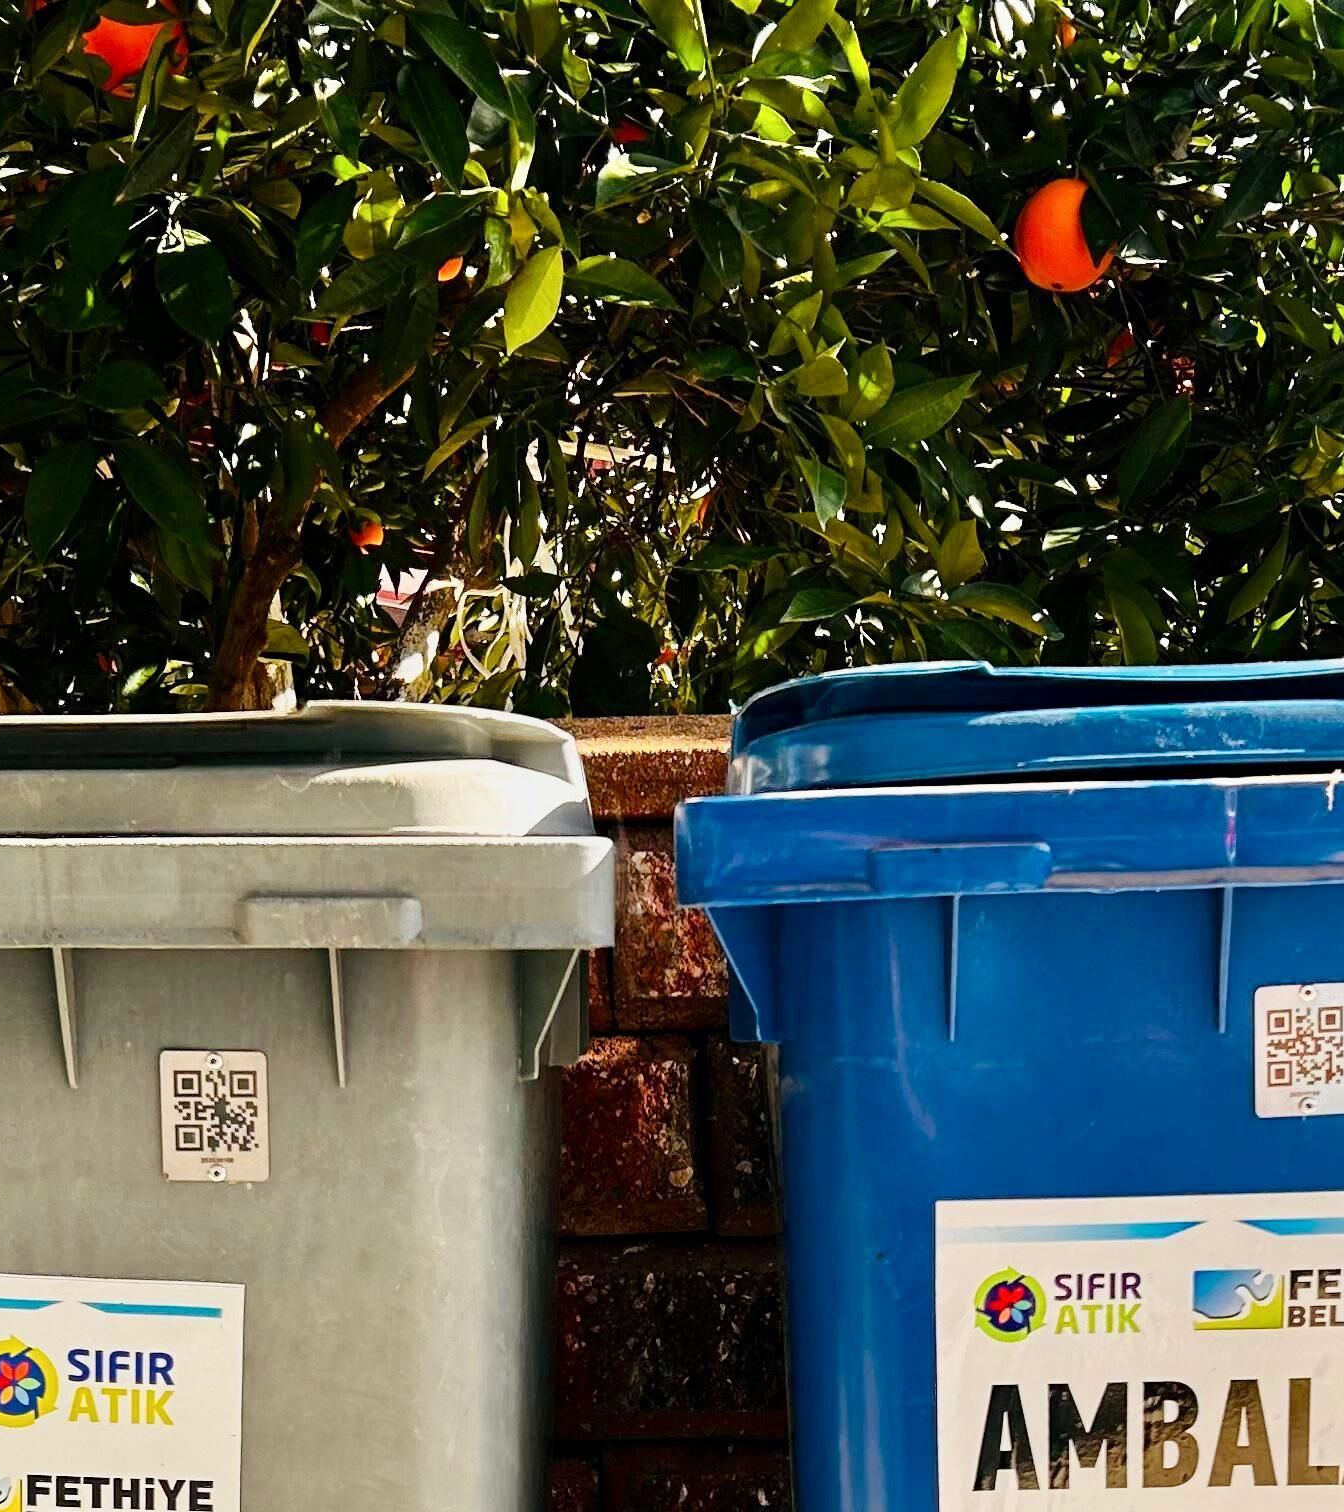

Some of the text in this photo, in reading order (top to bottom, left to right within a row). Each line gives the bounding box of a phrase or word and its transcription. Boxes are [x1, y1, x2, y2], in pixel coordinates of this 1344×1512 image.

[1054, 1271, 1141, 1301] SIFIR
[1055, 1304, 1141, 1335] ATIK
[67, 1349, 174, 1385] SIFIR
[68, 1386, 174, 1426] ATIK
